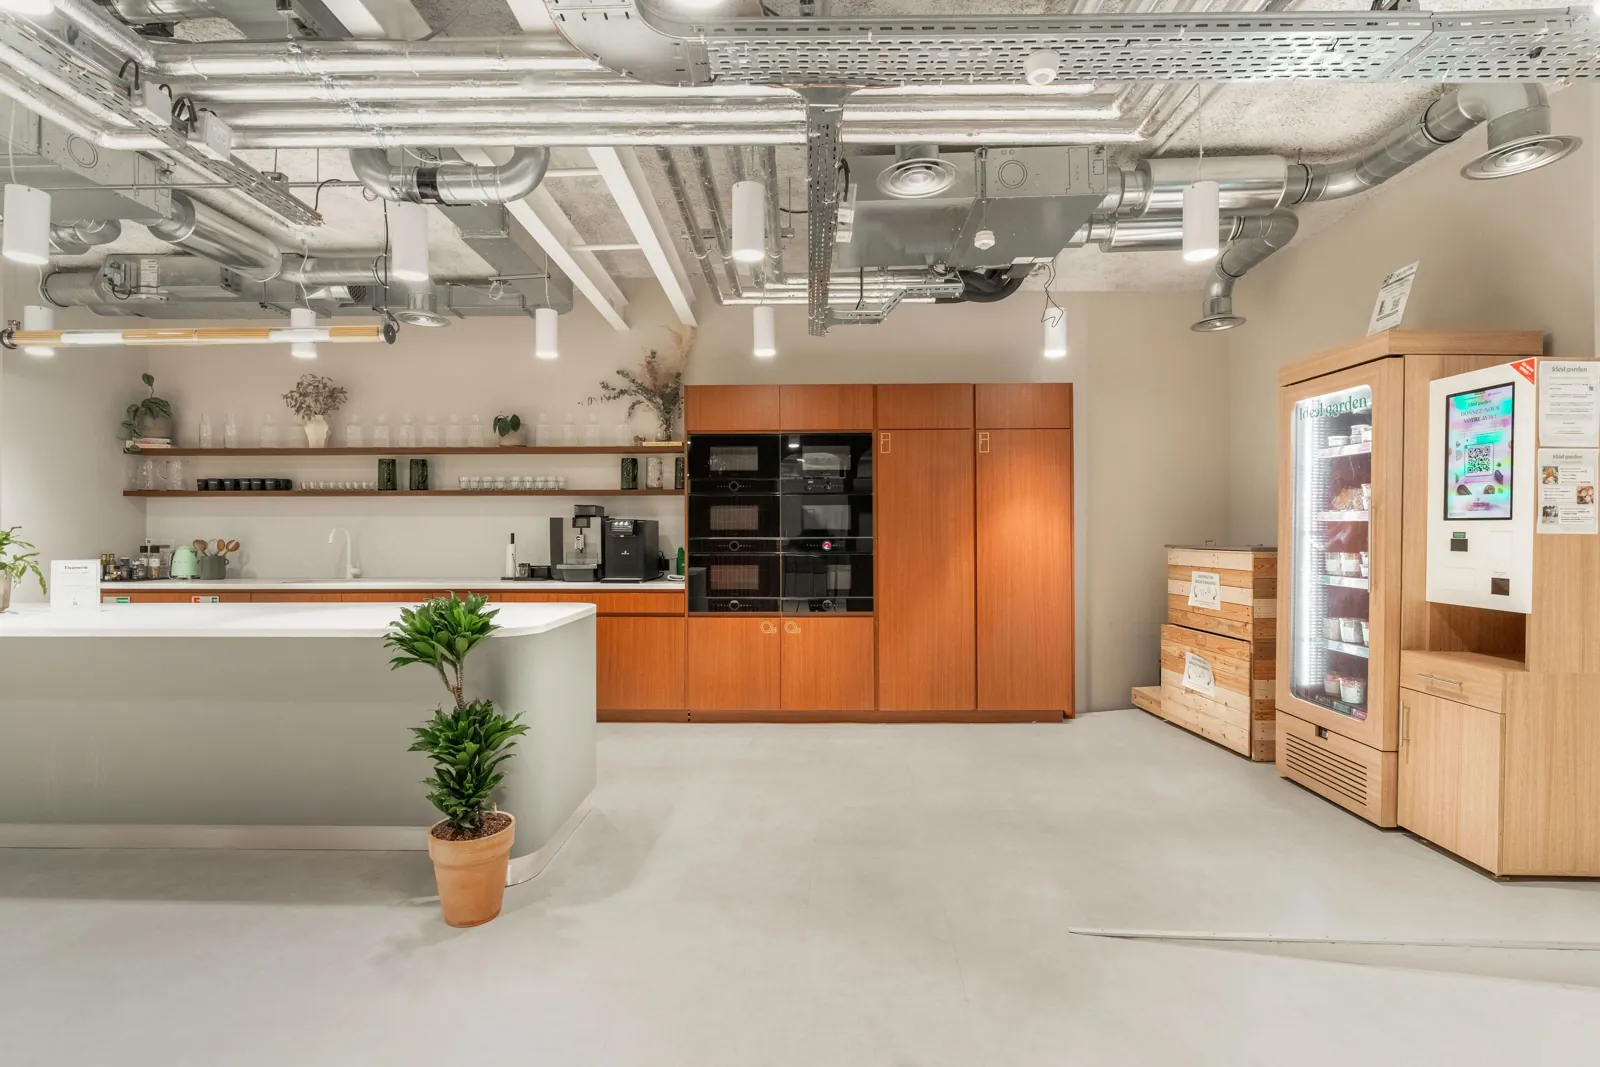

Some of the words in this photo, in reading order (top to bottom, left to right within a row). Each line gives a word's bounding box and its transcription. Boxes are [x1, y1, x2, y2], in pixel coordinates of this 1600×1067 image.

[1566, 366, 1588, 374] garden
[1325, 395, 1368, 418] garden
[1463, 416, 1480, 424] VOTRE
